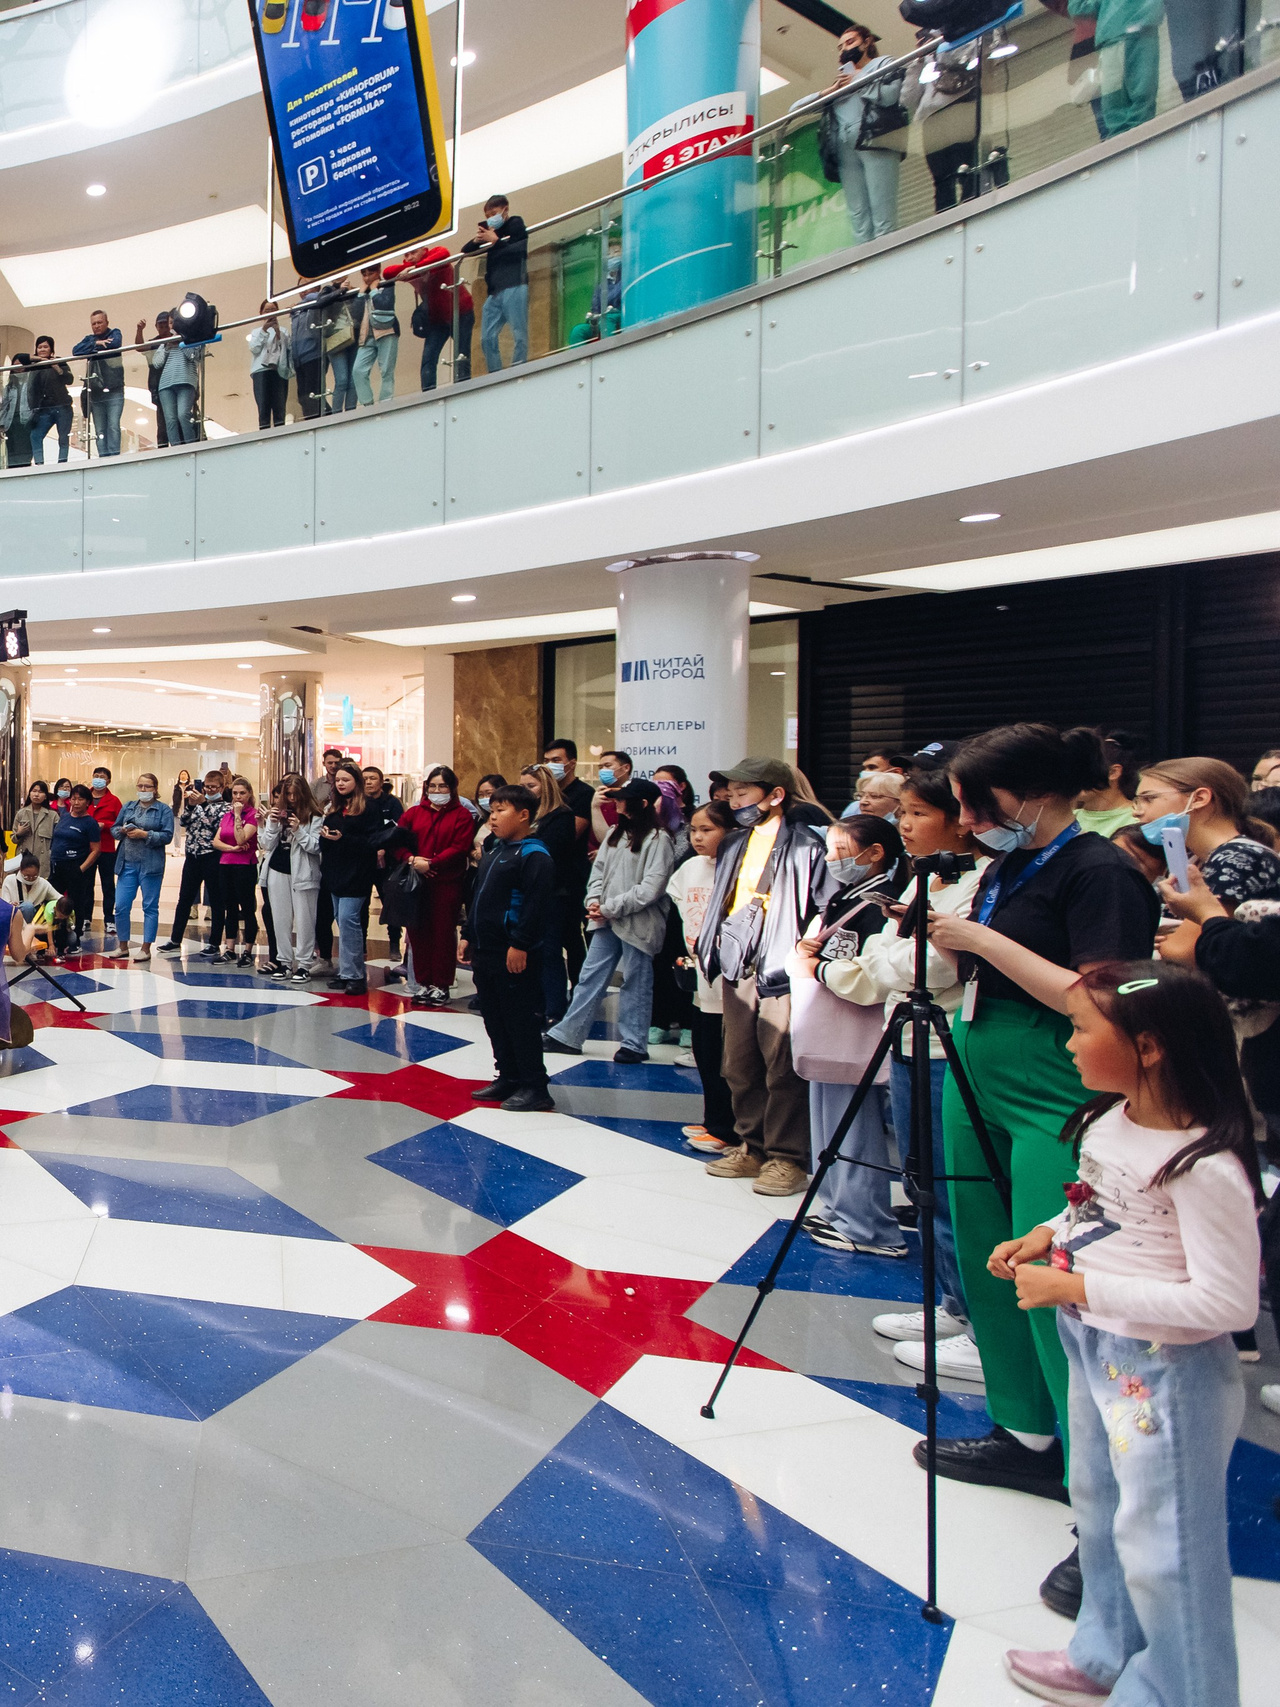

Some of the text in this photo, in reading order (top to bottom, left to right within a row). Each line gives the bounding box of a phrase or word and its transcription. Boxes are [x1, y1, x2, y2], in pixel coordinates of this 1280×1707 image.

[286, 98, 303, 113] Для
[288, 99, 335, 128] кинотеатра
[290, 82, 393, 140] ресторана «Песто Тесто»
[292, 98, 385, 149] автомойки «FORMULA»
[628, 104, 734, 165] ОТКРЫЛИСЬ!
[328, 140, 357, 159] 3 часа
[330, 146, 372, 170] парковки
[332, 155, 378, 181] бесплатно
[662, 153, 675, 170] 3
[652, 653, 705, 669] ЧИТАЙ
[652, 668, 705, 680] ГОРОД
[620, 720, 706, 733] БЕСТСЕЛЛЕРЫ
[1035, 844, 1060, 866] Colliers
[824, 936, 857, 961] 23
